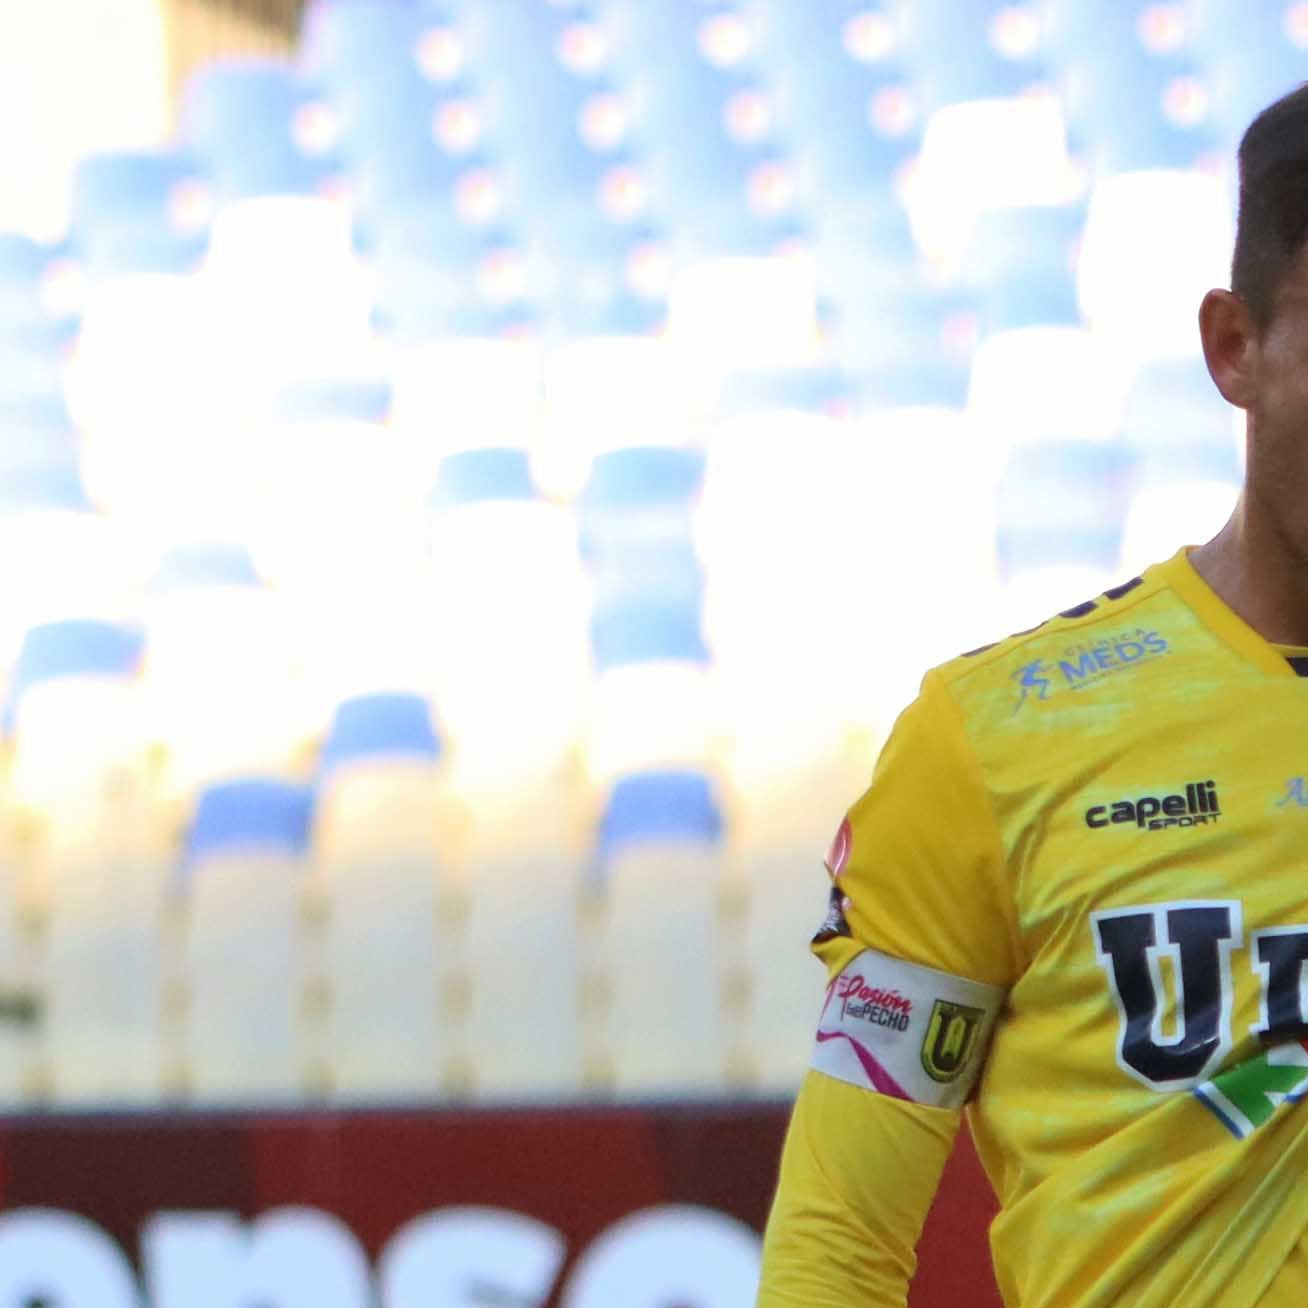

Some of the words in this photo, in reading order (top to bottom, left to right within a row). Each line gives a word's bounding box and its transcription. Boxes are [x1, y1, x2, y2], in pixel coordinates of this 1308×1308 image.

[1058, 631, 1169, 684] MEDS
[1084, 779, 1219, 829] capelli
[1146, 812, 1222, 832] SPORT
[862, 1002, 910, 1032] PECHO
